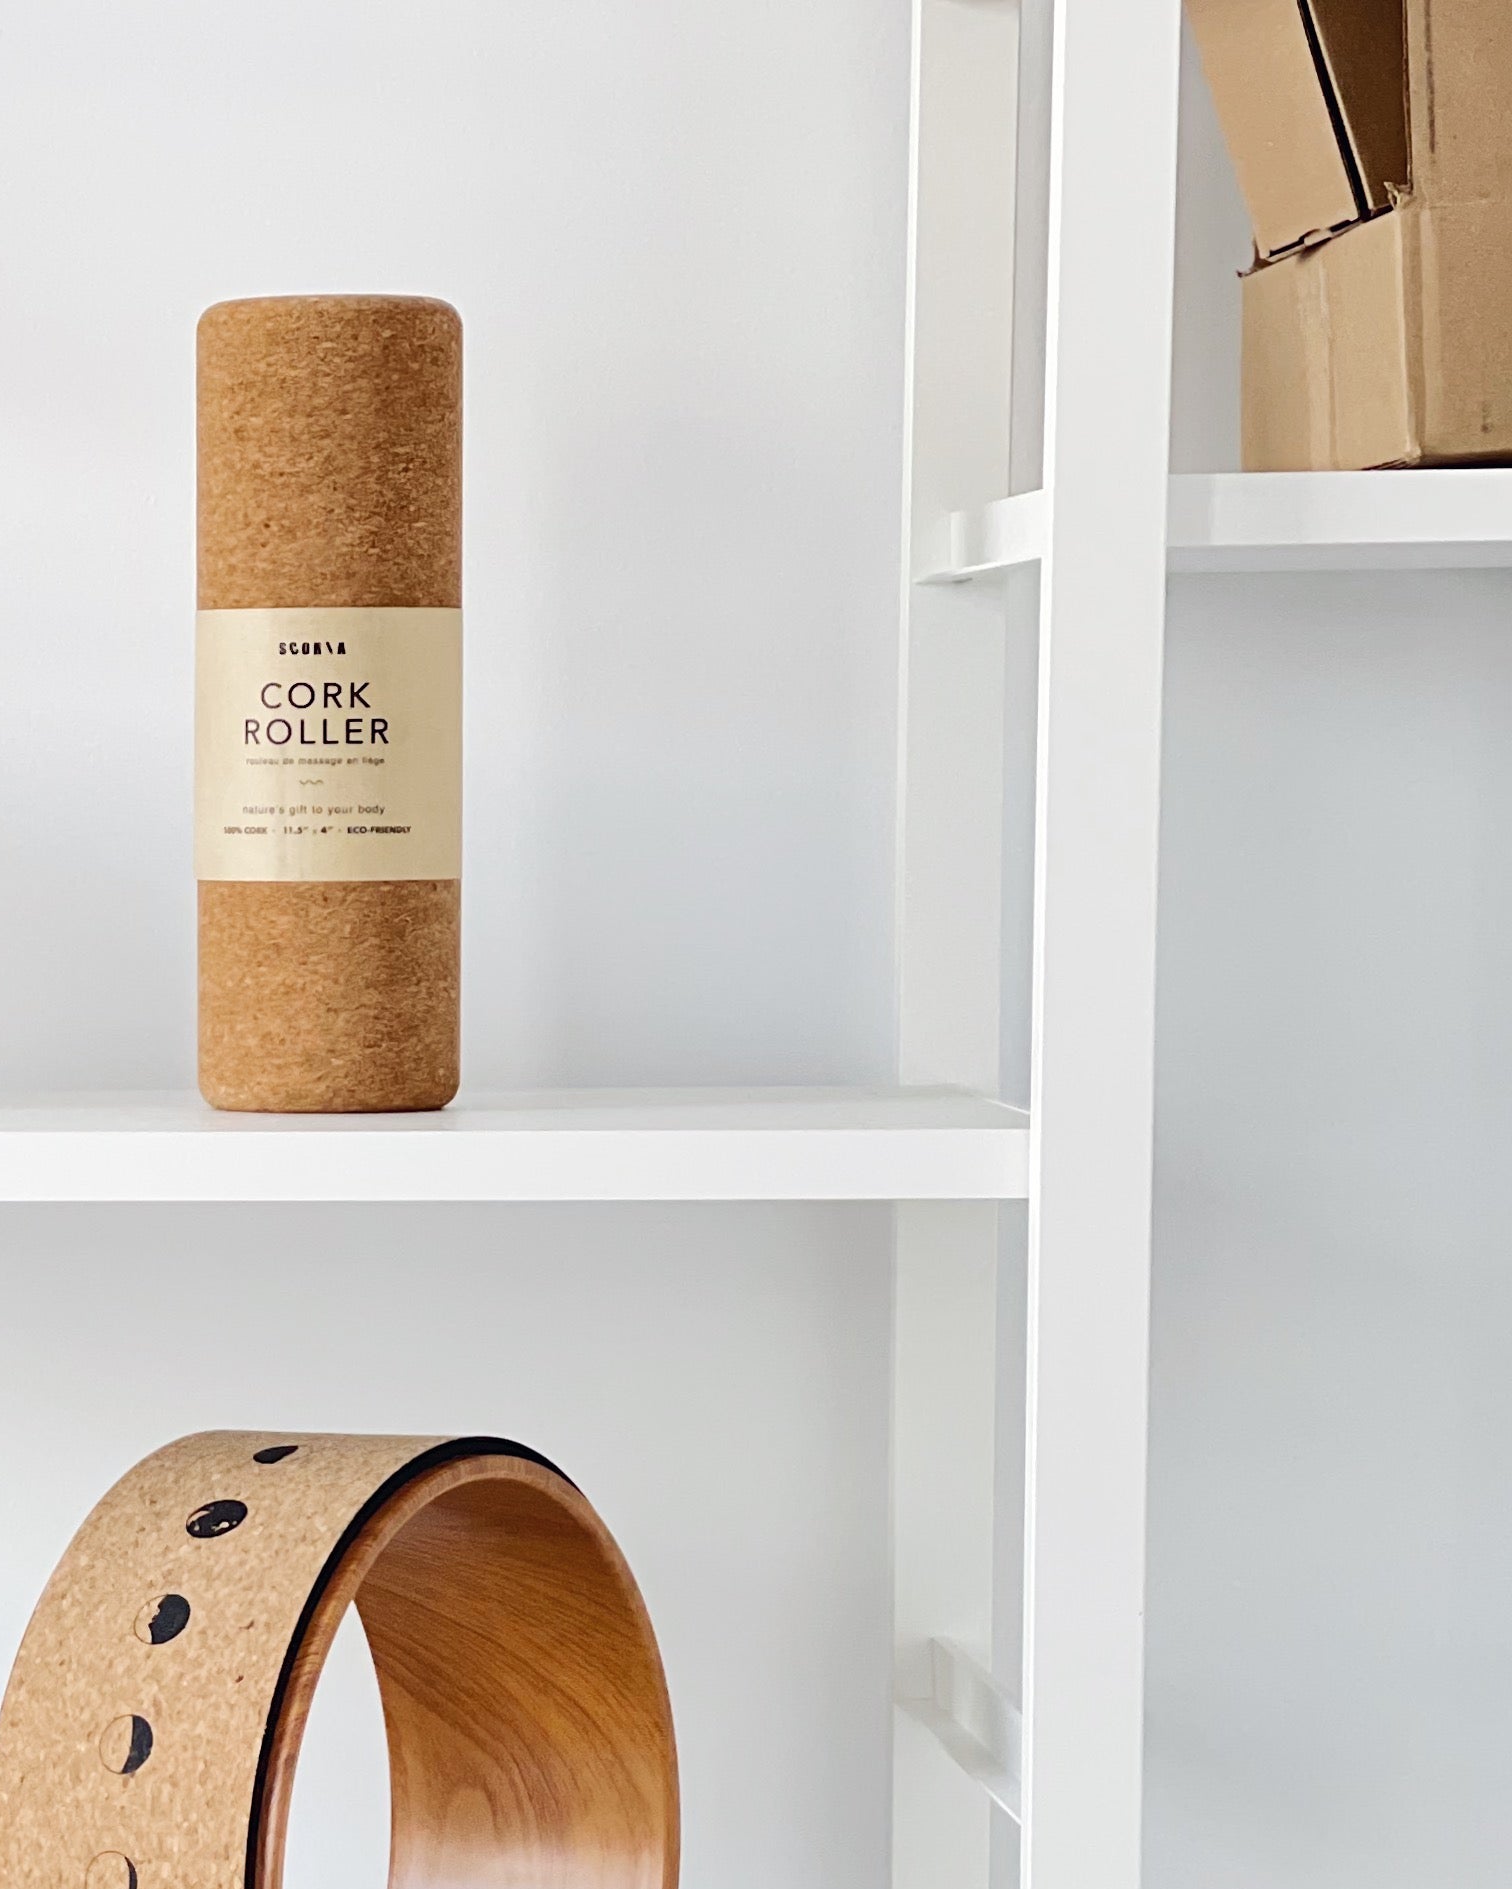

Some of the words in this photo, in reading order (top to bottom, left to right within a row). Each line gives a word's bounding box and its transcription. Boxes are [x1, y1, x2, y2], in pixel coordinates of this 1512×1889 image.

[260, 682, 372, 709] CORK
[244, 718, 390, 745] ROLLER
[289, 804, 307, 817] gift
[312, 805, 323, 815] to
[328, 806, 353, 817] your
[358, 804, 386, 816] body
[347, 826, 412, 834] ECO-FRIENDLY
